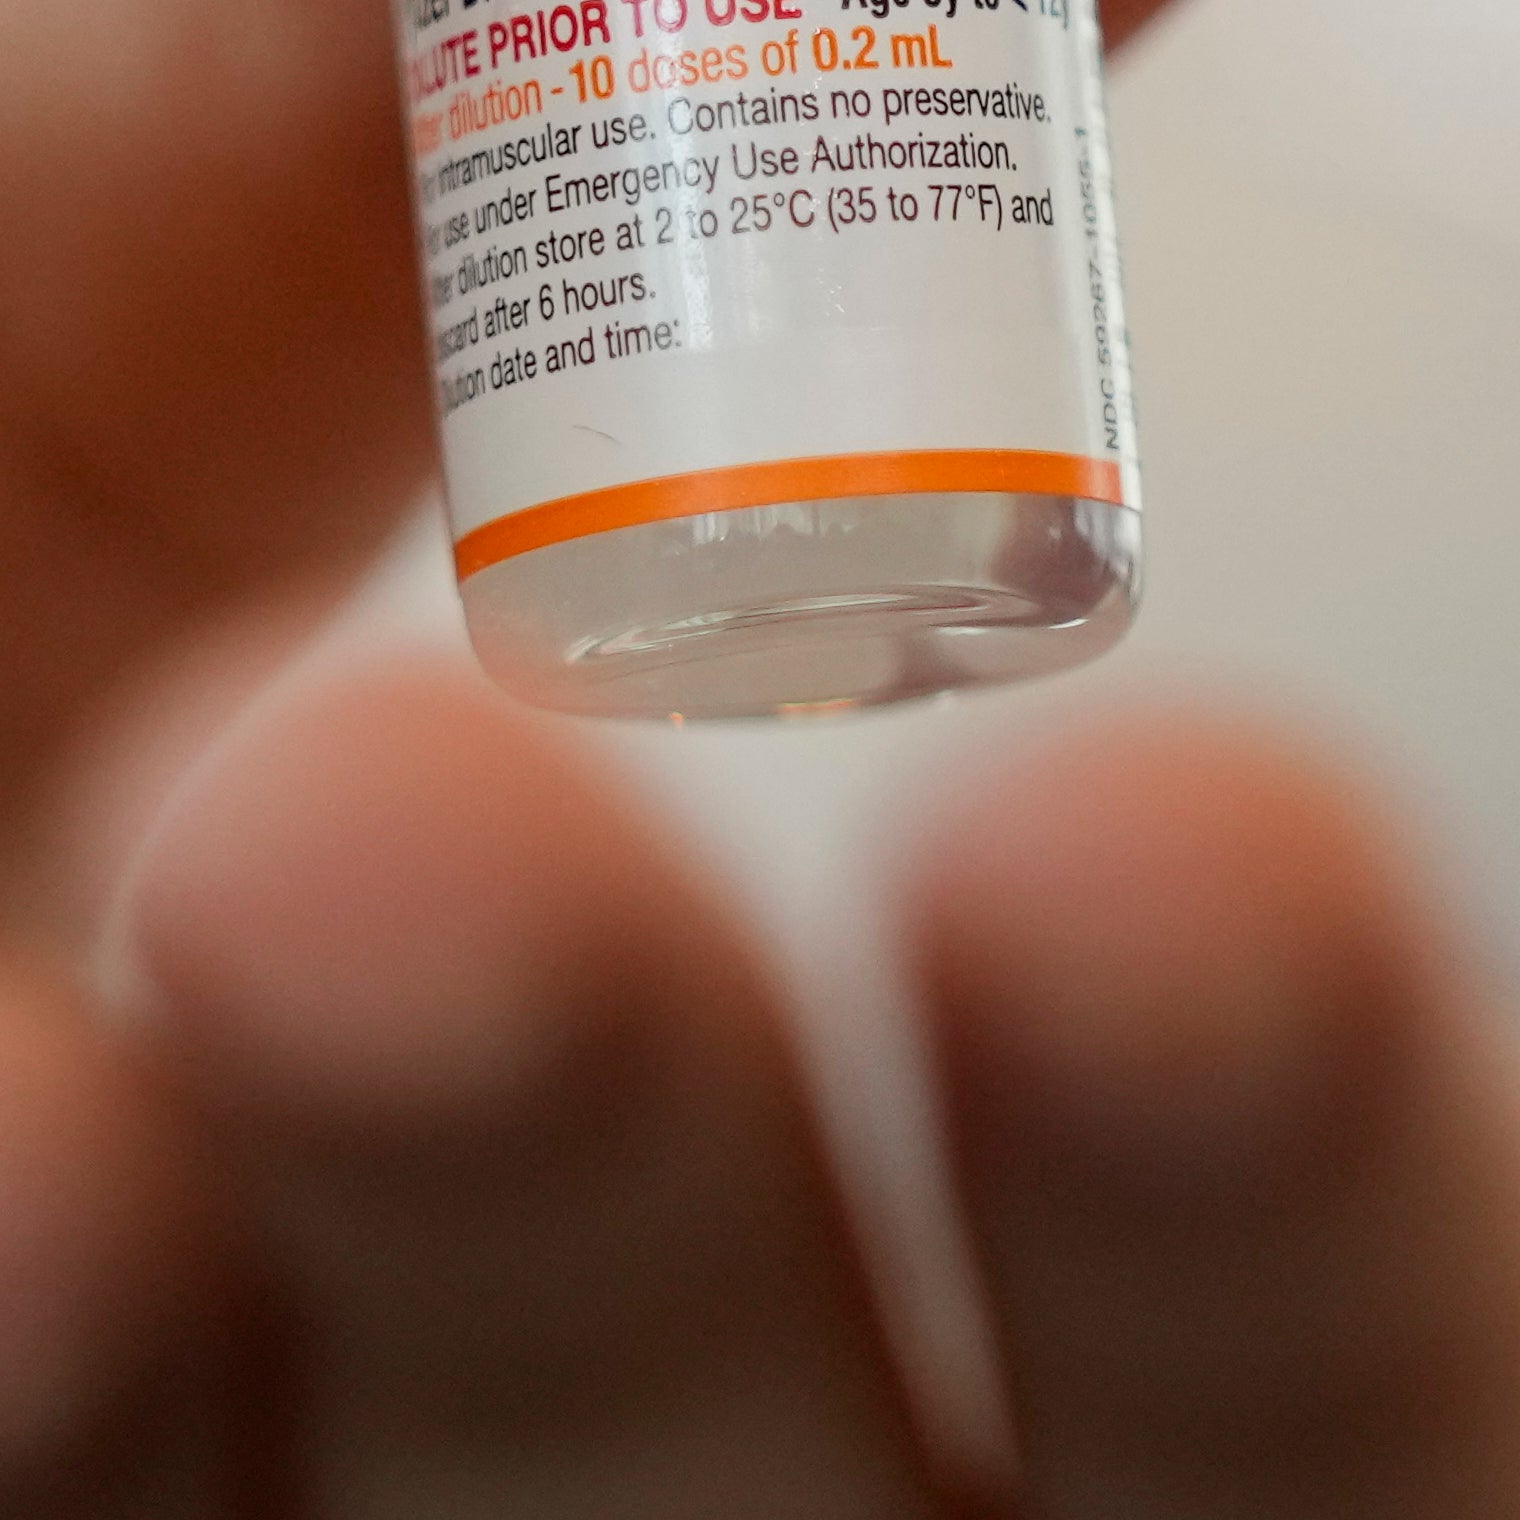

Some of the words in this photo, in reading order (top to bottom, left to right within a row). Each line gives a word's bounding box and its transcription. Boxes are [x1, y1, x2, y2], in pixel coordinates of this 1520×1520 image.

[448, 80, 543, 142] dilution
[568, 54, 615, 104] 10
[627, 44, 749, 94] doses
[761, 28, 799, 76] of
[811, 24, 880, 73] 0.2
[890, 23, 953, 69] mL
[591, 113, 657, 150] use.
[668, 86, 820, 135] Contains
[830, 89, 872, 118] no
[882, 81, 1053, 126] preservative.
[475, 186, 537, 234] under
[544, 154, 719, 213] Emergency
[731, 141, 799, 180] Use
[811, 131, 1018, 174] Authorization.
[457, 245, 528, 296] dilution
[535, 228, 606, 268] store
[616, 213, 645, 251] at
[654, 207, 675, 244] 2
[685, 209, 719, 240] to
[730, 188, 815, 235] 25°C
[827, 185, 877, 235] (35
[887, 186, 919, 222] to
[927, 183, 1003, 232] 77°F)
[1011, 187, 1055, 226] and
[484, 296, 531, 340] after
[538, 283, 555, 321] 6
[562, 272, 657, 314] hours.
[490, 346, 538, 390] date
[545, 325, 596, 374] and
[603, 319, 682, 361] time:
[1100, 378, 1120, 451] NDC
